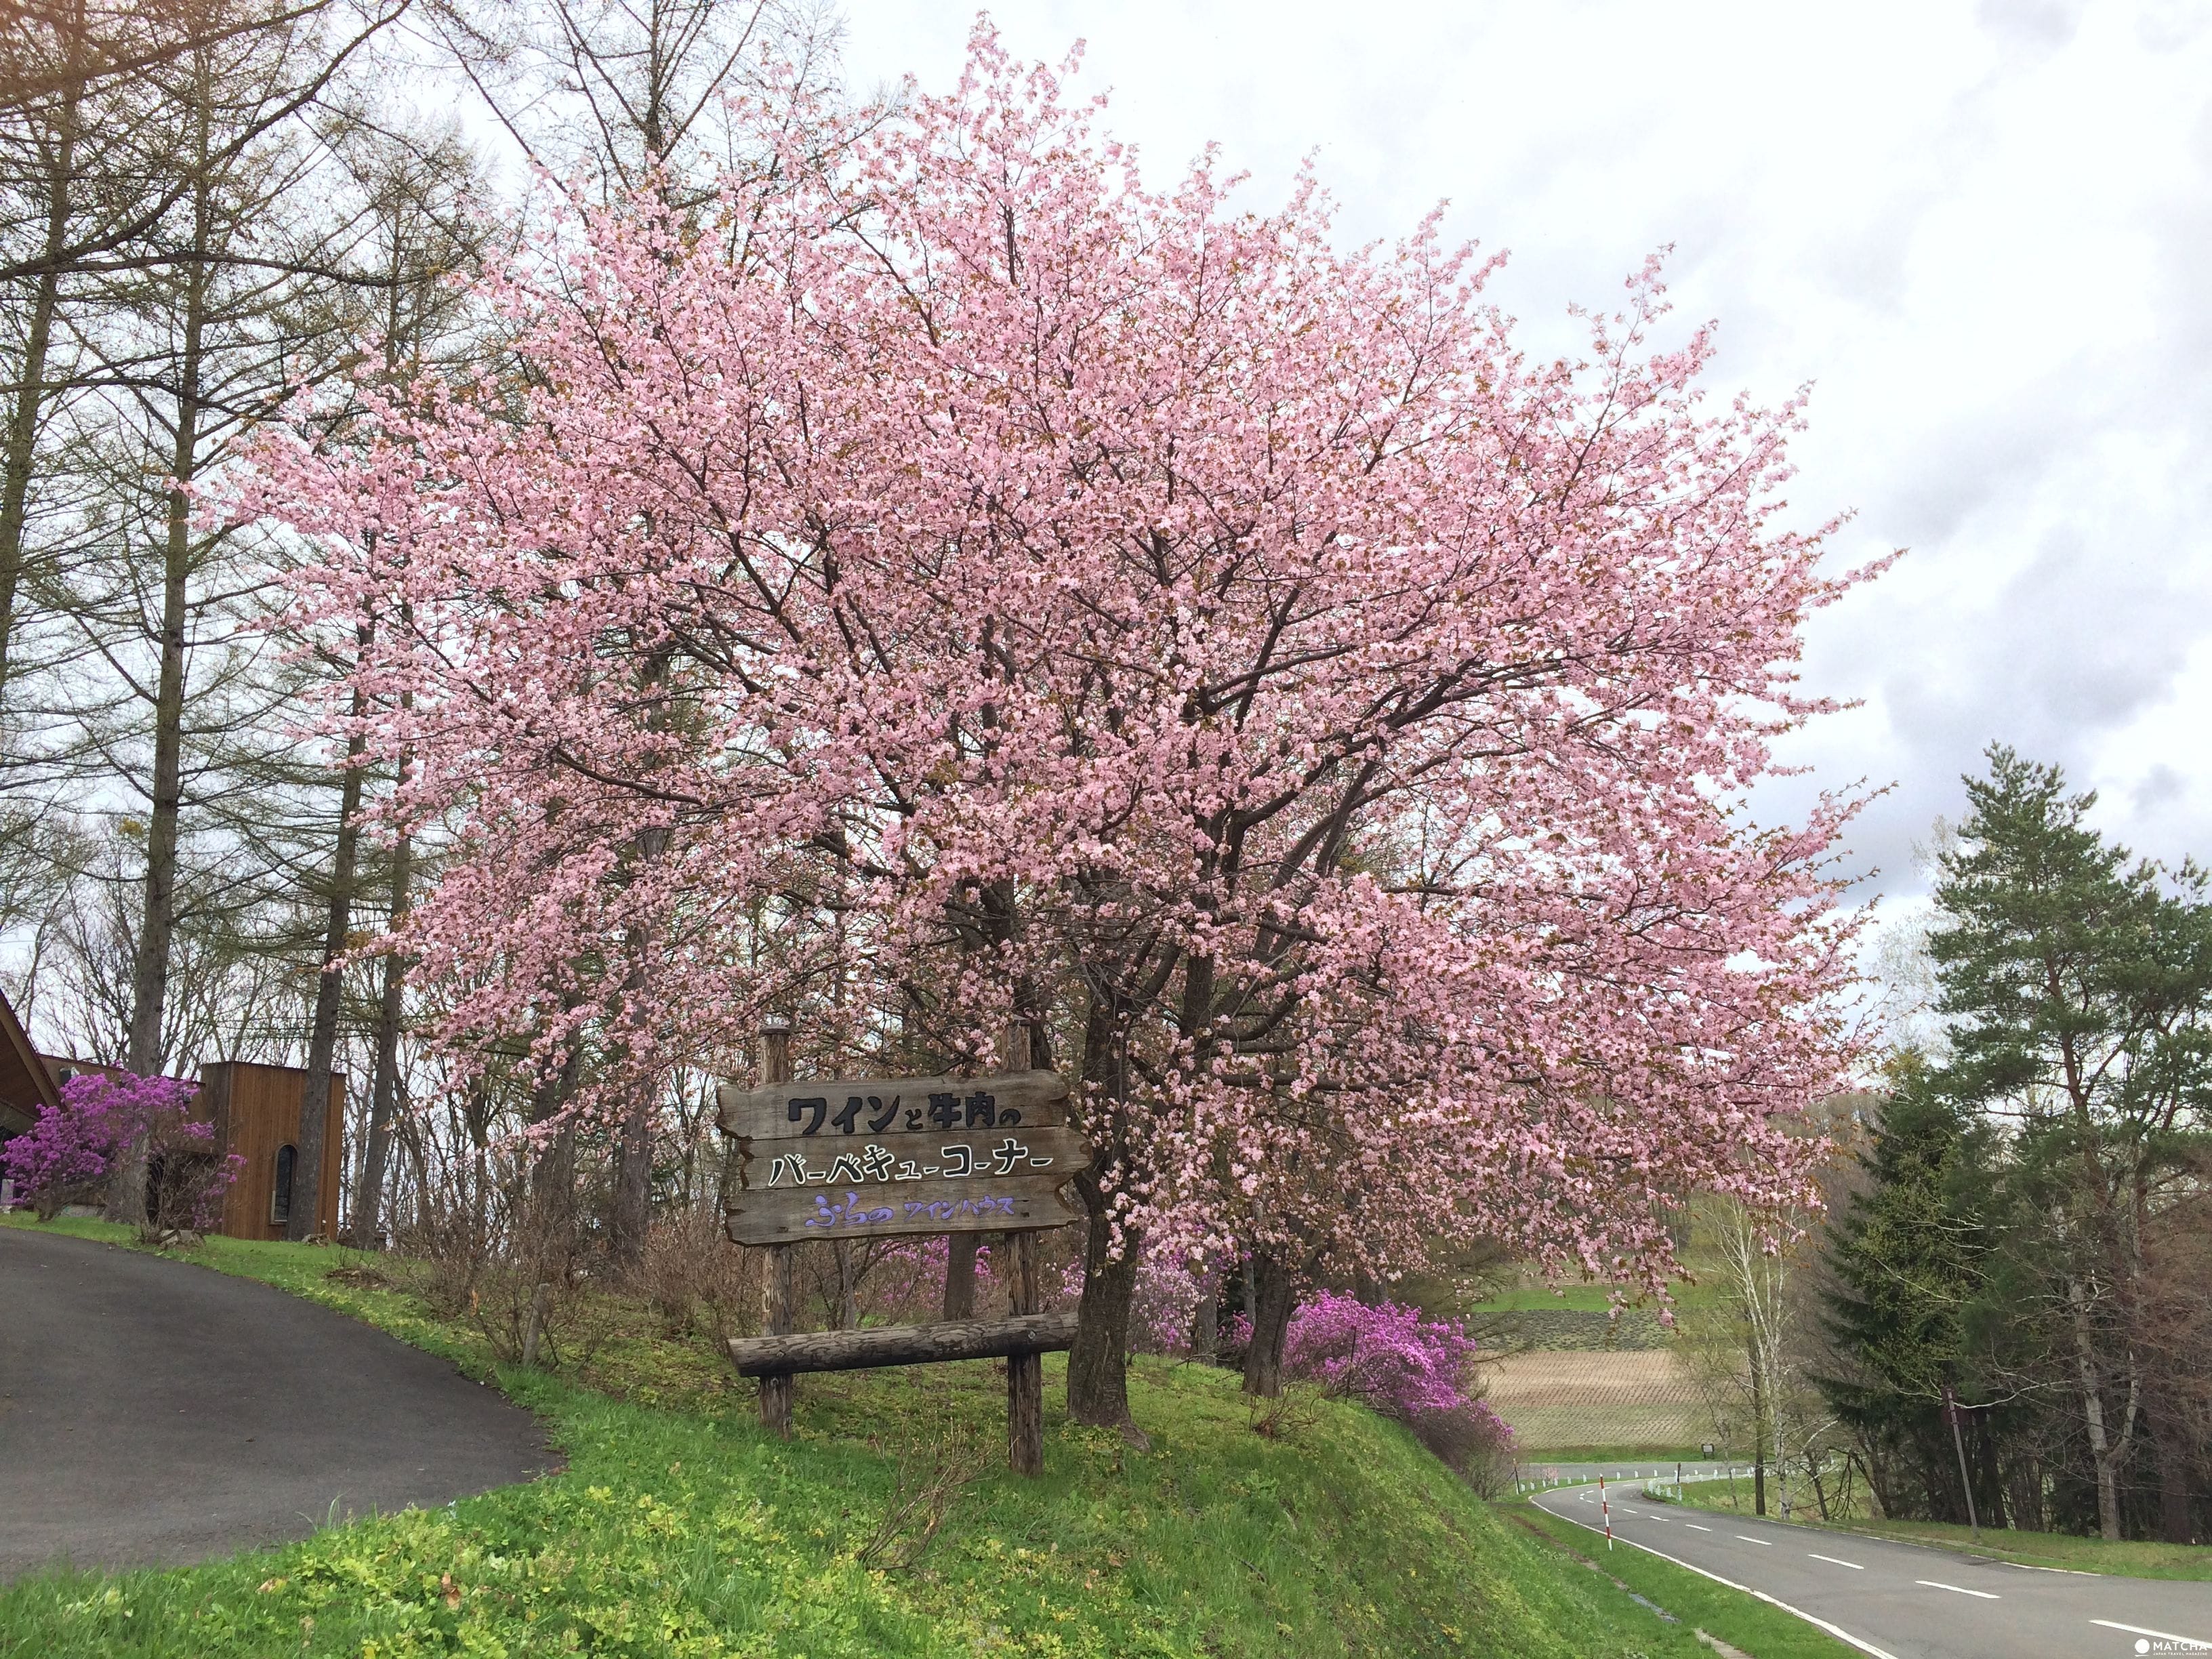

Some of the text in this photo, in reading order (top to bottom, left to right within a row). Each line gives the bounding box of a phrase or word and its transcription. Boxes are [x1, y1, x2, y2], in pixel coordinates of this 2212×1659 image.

[788, 1091, 1022, 1135] ワインと牛肉の
[768, 1138, 1054, 1187] バーベキューコーナー
